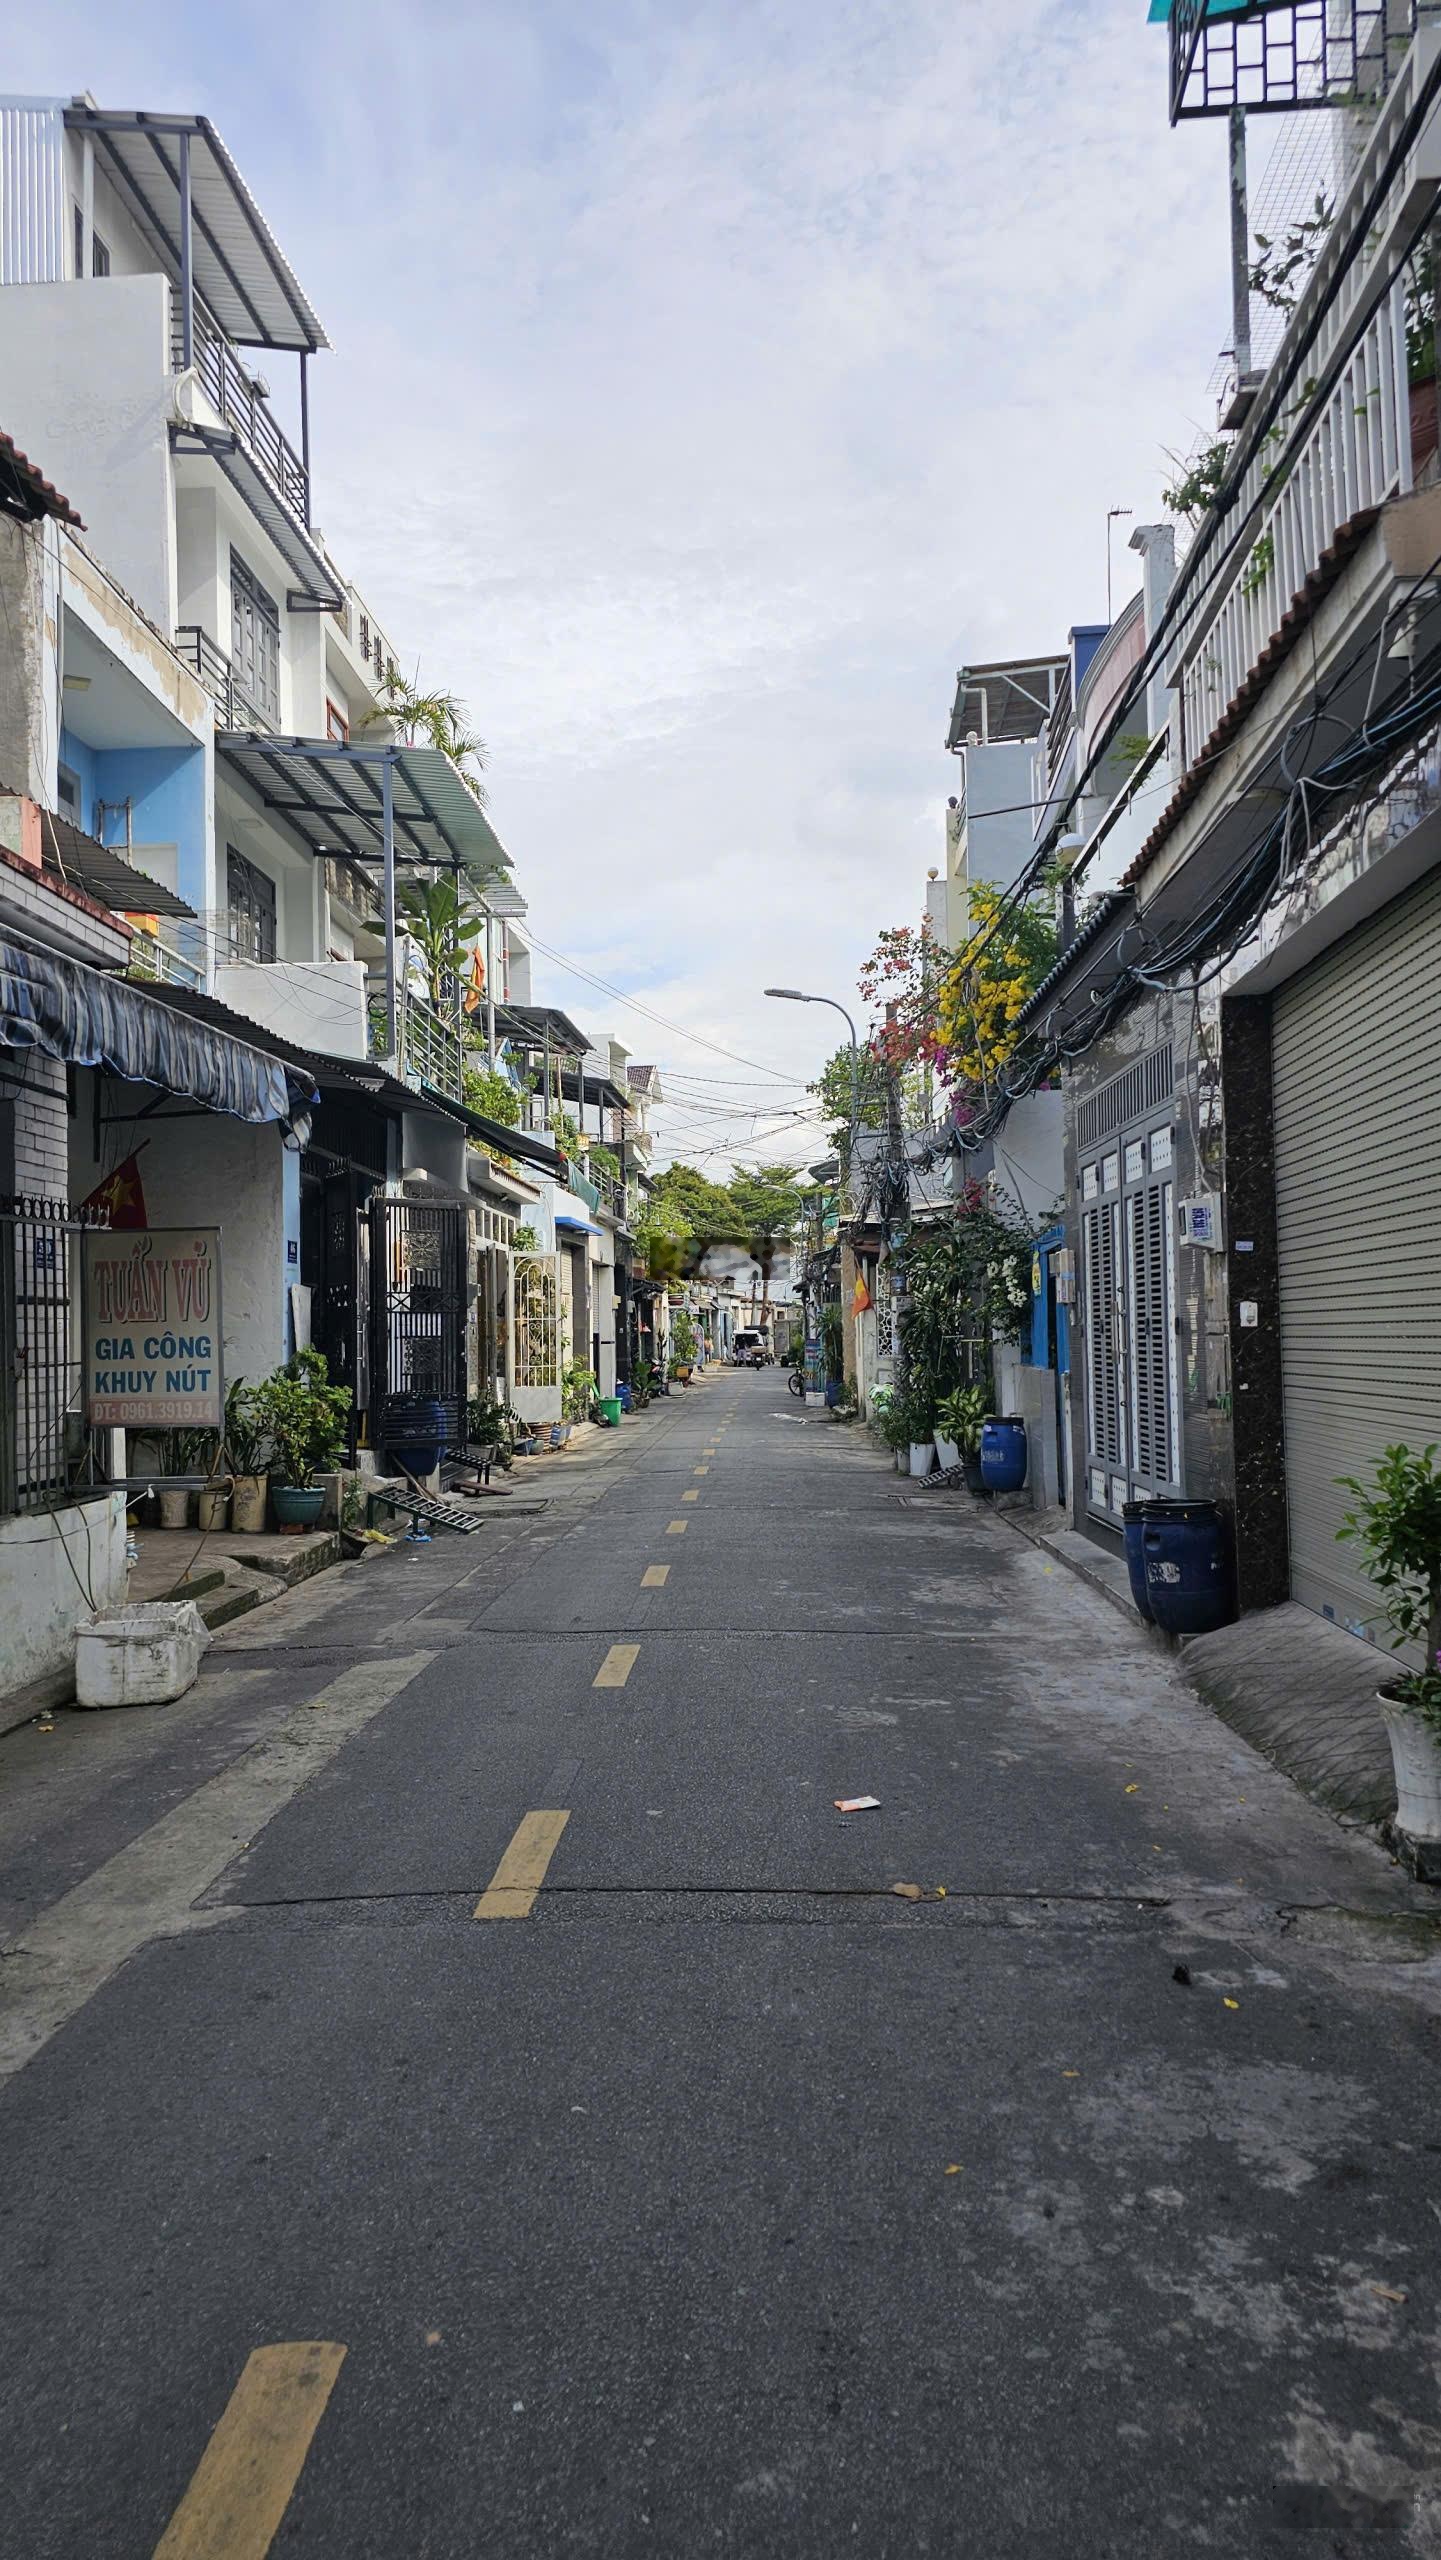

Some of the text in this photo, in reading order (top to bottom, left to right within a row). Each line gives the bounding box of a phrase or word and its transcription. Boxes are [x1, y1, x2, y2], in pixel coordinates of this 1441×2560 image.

[94, 1236, 167, 1323] TUẤN
[95, 1331, 211, 1360] GIA CÔNG
[95, 1364, 212, 1393] KHUY NÚT
